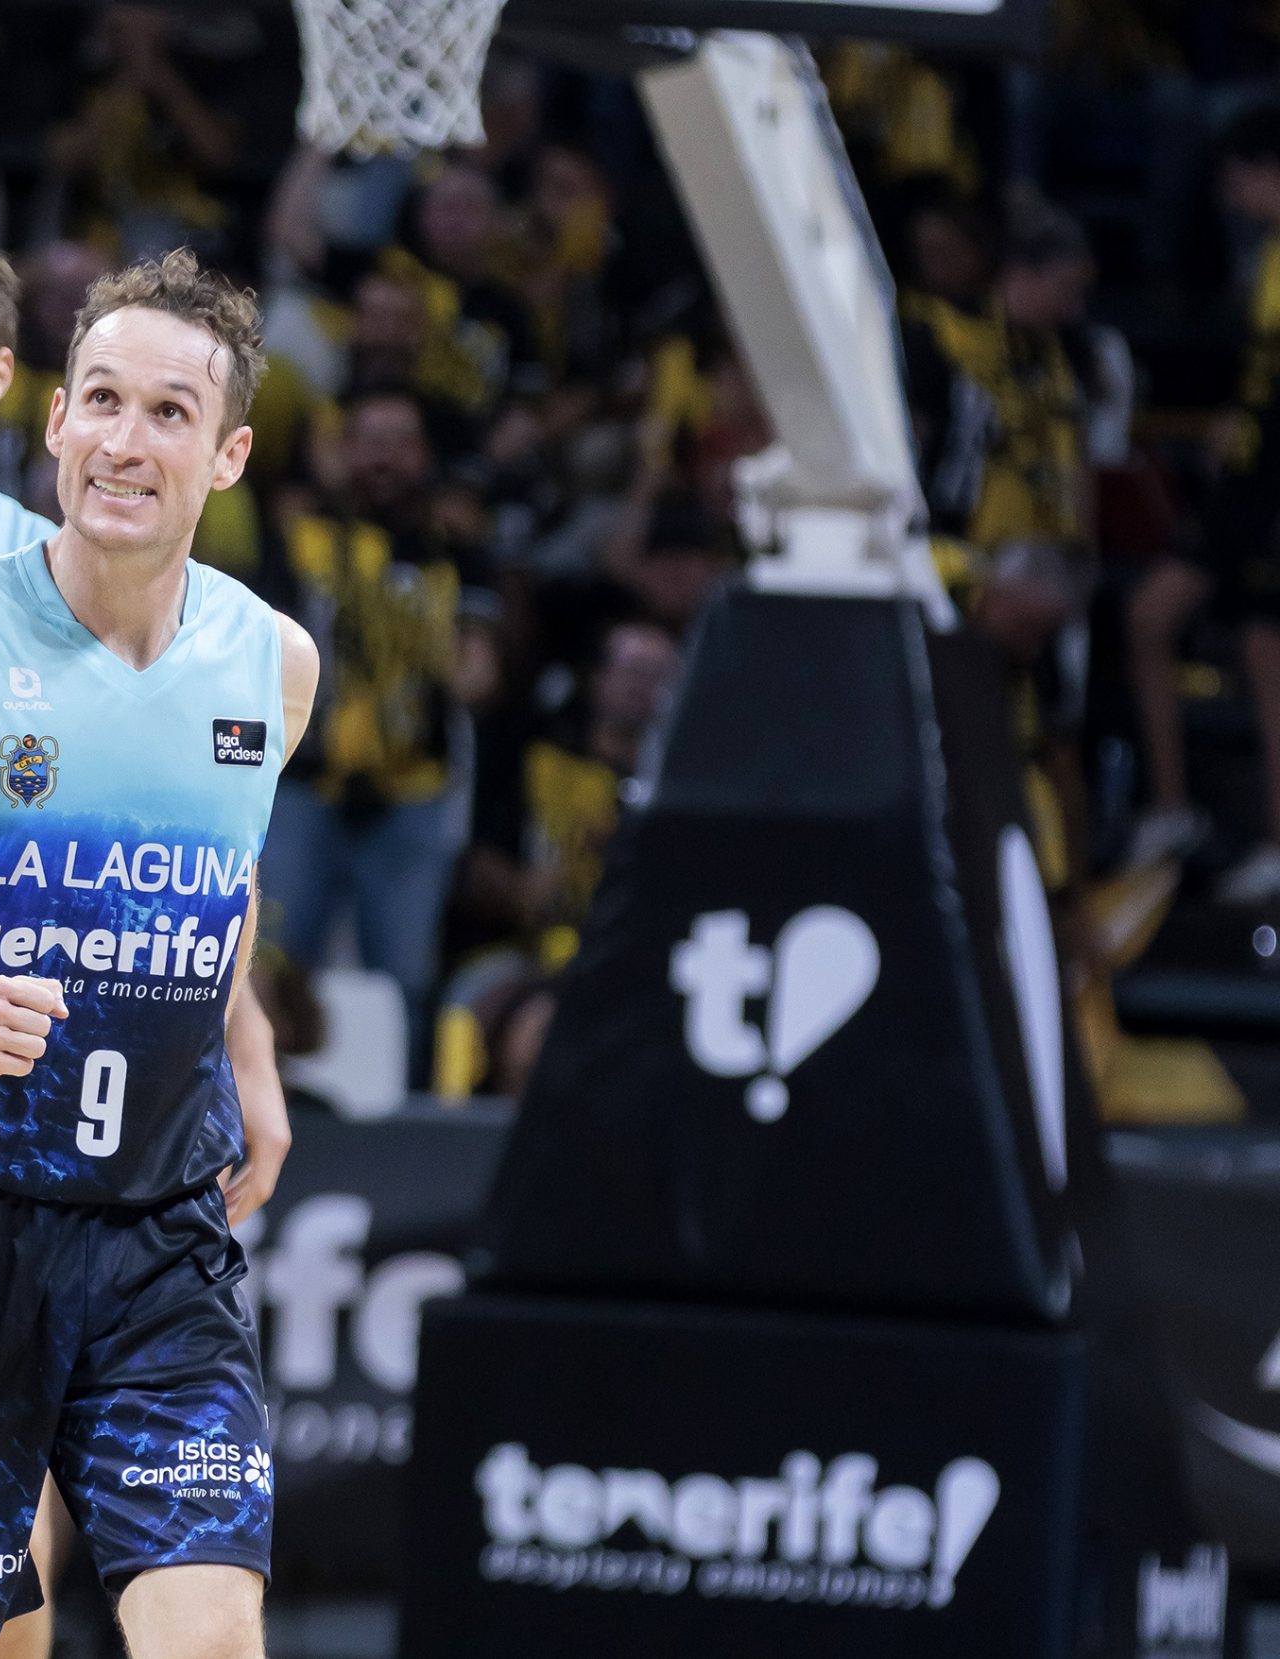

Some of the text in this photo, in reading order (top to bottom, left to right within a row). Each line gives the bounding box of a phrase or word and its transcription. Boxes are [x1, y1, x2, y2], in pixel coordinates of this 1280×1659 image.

[216, 732, 240, 748] liga
[218, 747, 263, 761] endesa
[63, 841, 252, 897] LAGUNA
[76, 1049, 128, 1158] 9
[178, 1439, 241, 1462] Islas
[121, 1459, 242, 1487] Canarias
[209, 1488, 221, 1498] DE
